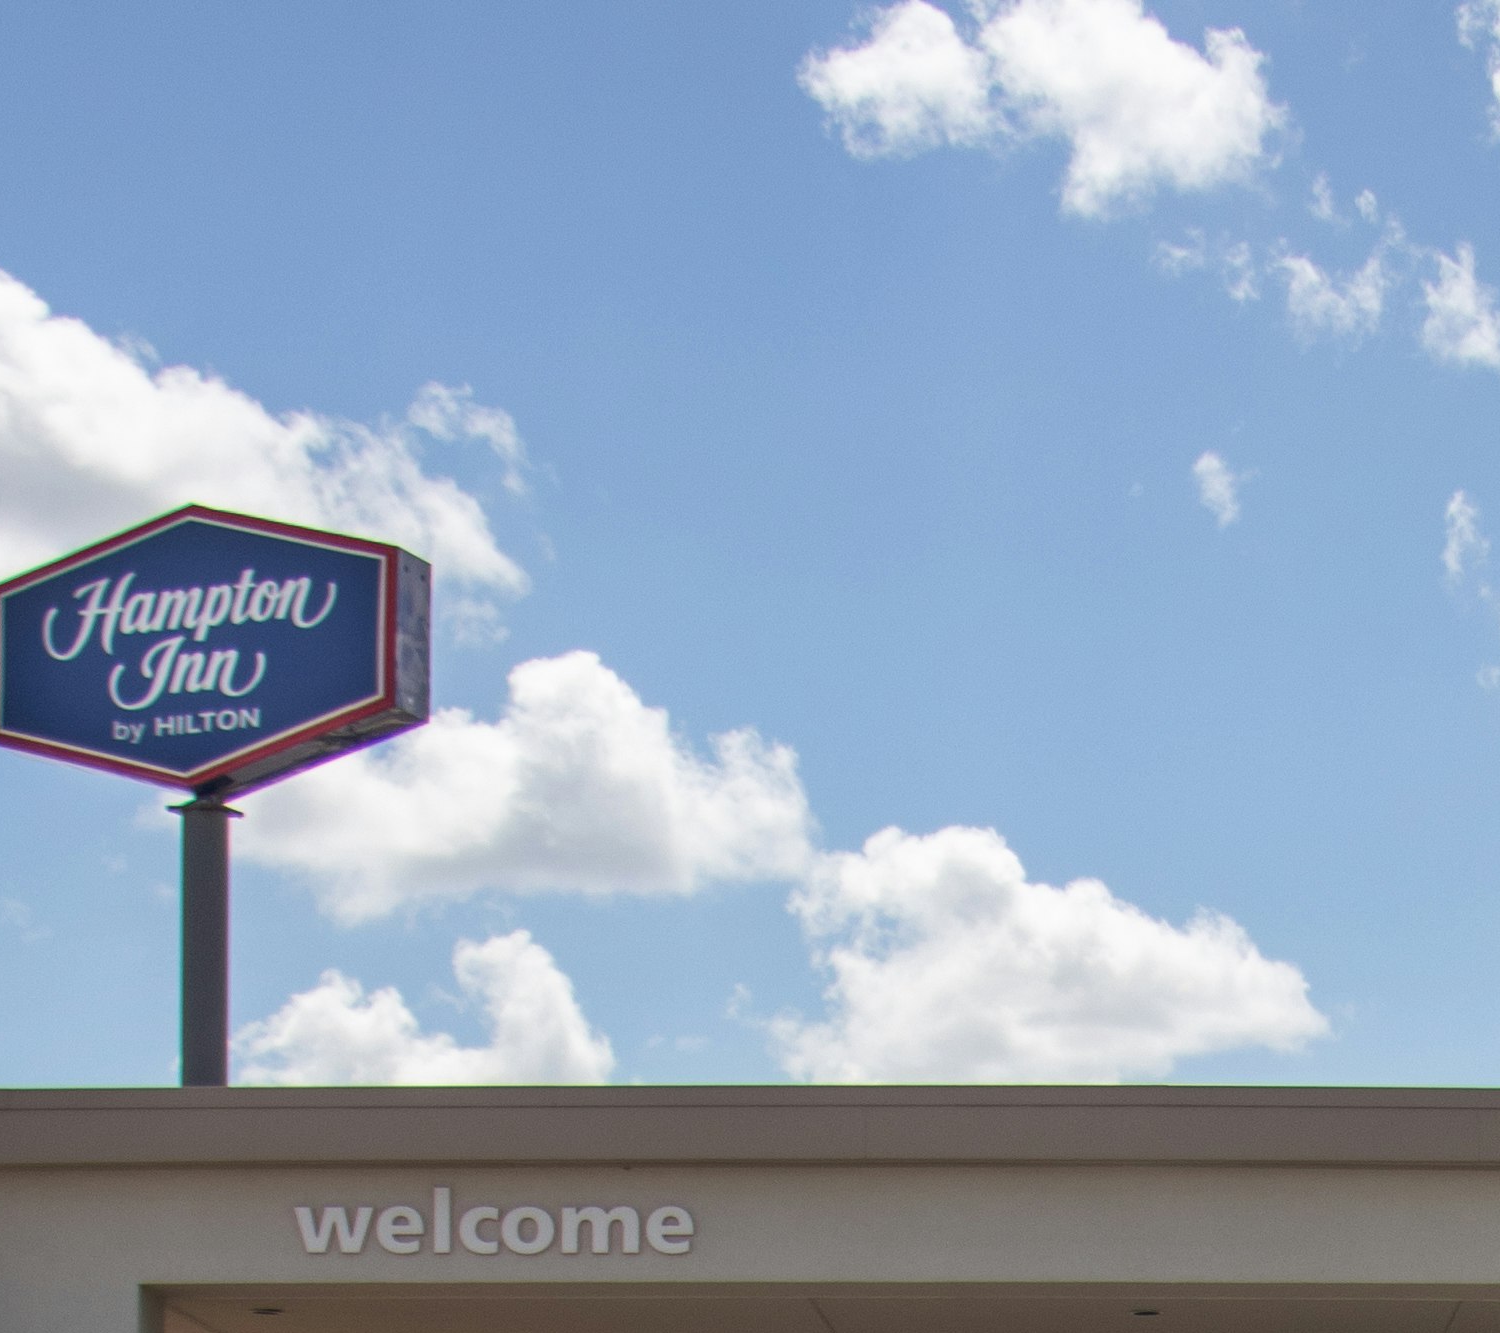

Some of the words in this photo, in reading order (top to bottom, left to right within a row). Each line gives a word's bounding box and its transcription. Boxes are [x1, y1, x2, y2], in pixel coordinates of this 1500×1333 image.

[41, 567, 337, 662] Hampton
[107, 634, 266, 711] Inn
[112, 719, 145, 744] by
[153, 707, 261, 738] HILTON
[294, 1186, 695, 1255] welcome
